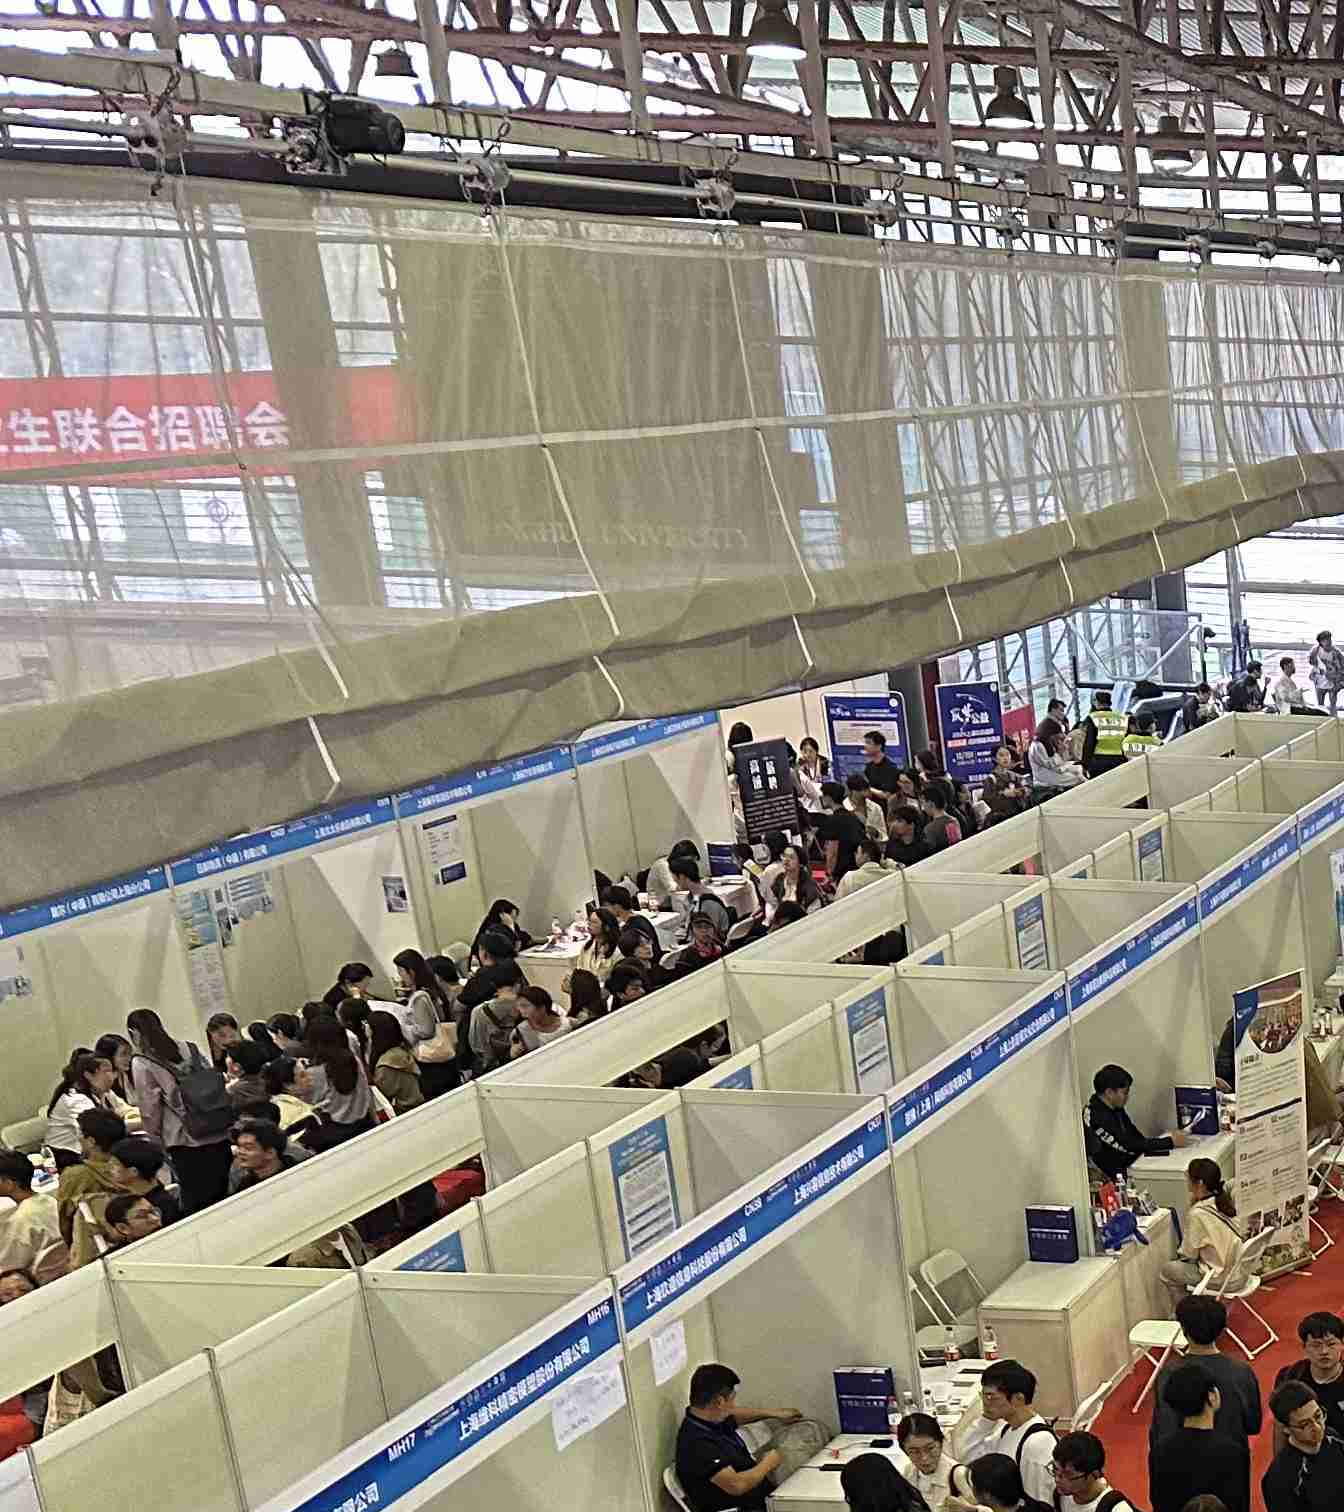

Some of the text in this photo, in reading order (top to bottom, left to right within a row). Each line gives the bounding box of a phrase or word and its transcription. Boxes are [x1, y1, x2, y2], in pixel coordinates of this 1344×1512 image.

[0, 401, 289, 454] 生联合招聘会
[587, 1304, 611, 1325] MH16
[388, 1434, 417, 1462] MH17
